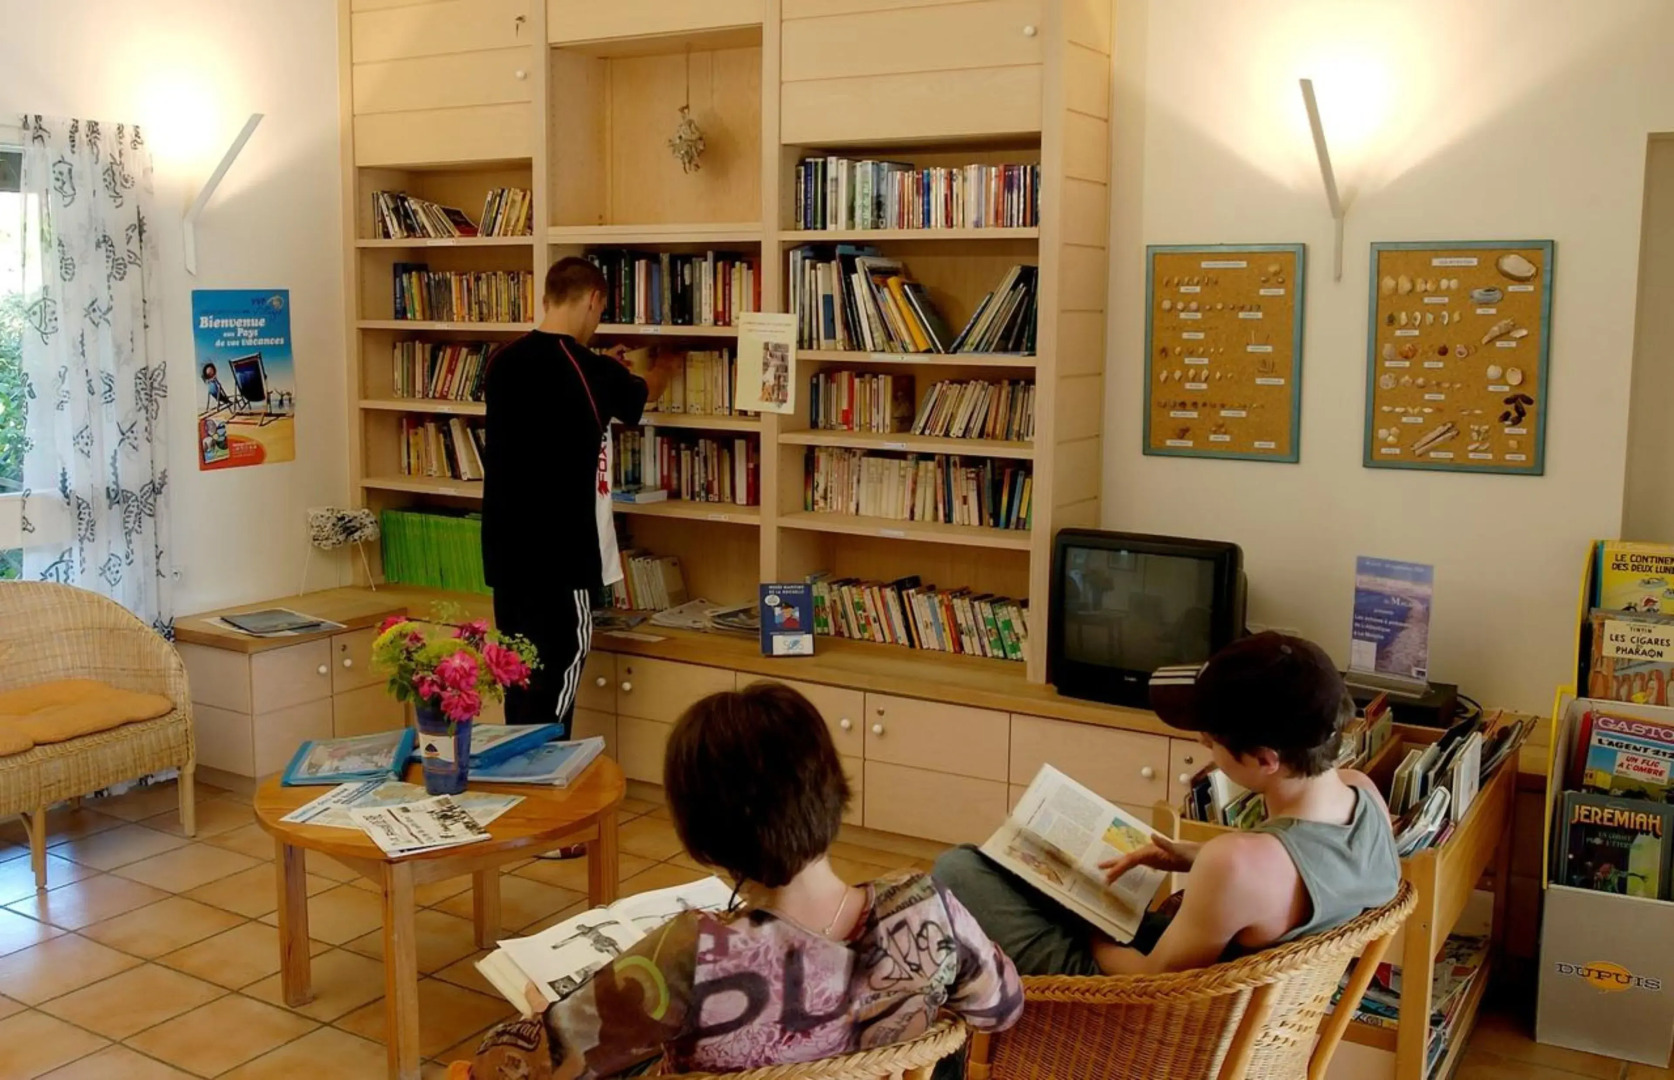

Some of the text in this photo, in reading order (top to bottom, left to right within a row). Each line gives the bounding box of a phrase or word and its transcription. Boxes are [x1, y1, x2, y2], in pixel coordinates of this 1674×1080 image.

[199, 315, 265, 328] Bienvenue
[237, 327, 259, 338] Pays
[241, 337, 285, 347] vacances
[1614, 554, 1627, 562] LE
[1612, 562, 1629, 571] DES
[1631, 564, 1653, 573] DEUX
[1630, 626, 1652, 634] TINTIN
[1609, 633, 1671, 647] LES CIGARES
[1615, 645, 1663, 658] PHARAON
[1597, 737, 1650, 754] L'AGENT
[1625, 755, 1660, 769] UN FLIC
[1625, 762, 1666, 777] L'OMBRE
[1571, 805, 1663, 836] JEREMIAH
[1555, 962, 1661, 991] DUPUIS
